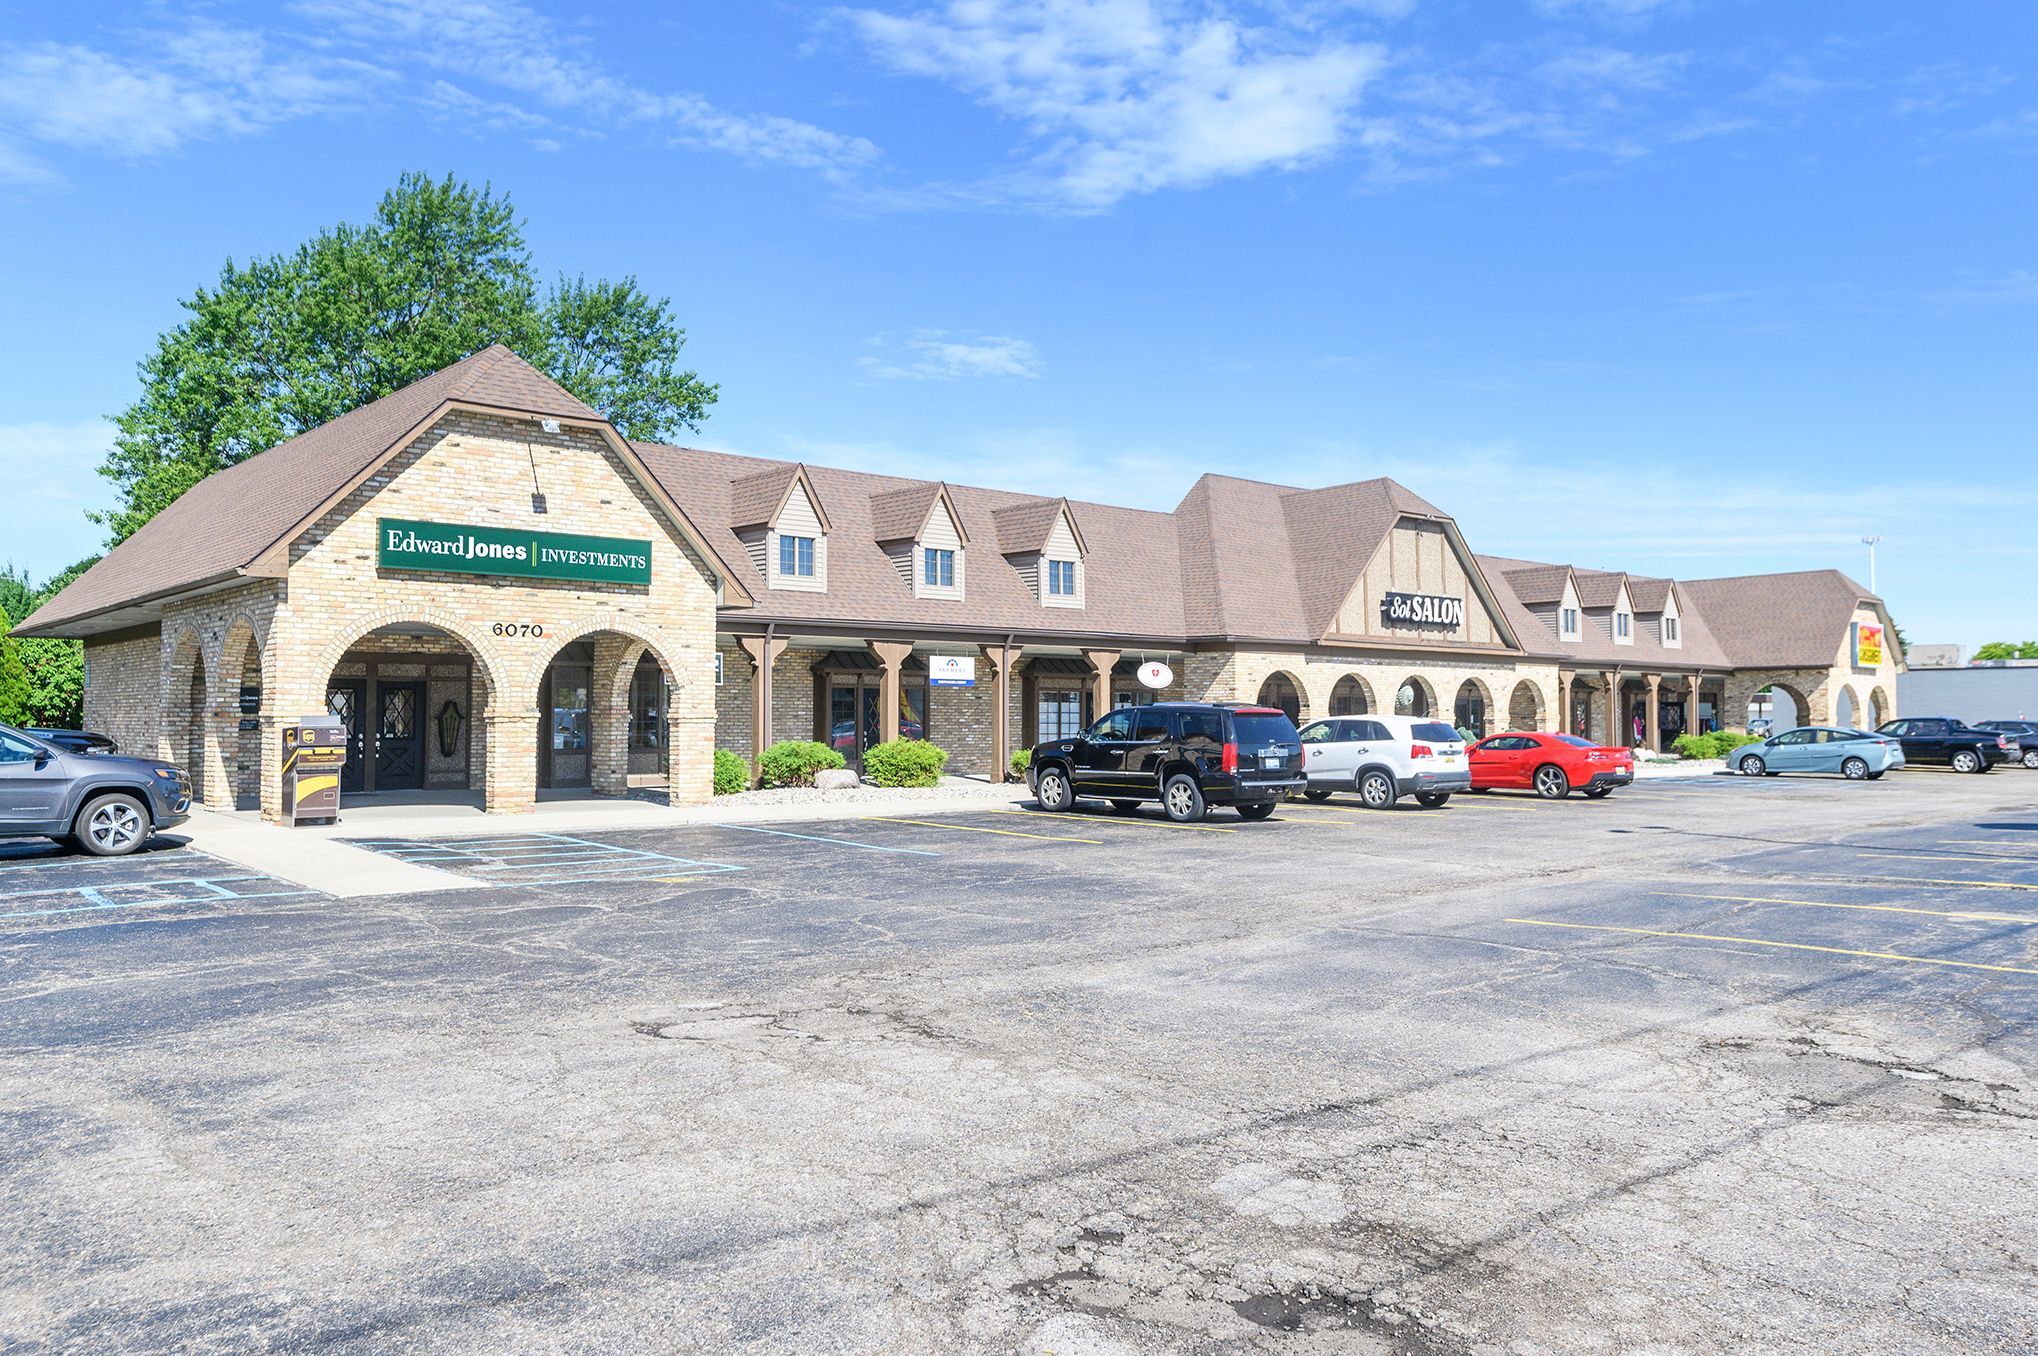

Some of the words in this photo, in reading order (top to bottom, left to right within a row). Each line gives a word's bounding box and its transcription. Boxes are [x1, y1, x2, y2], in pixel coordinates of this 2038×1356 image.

[541, 548, 646, 569] INVESTMENTS
[1390, 596, 1411, 618] Sol
[1411, 596, 1464, 625] SALON
[492, 622, 543, 638] 6070
